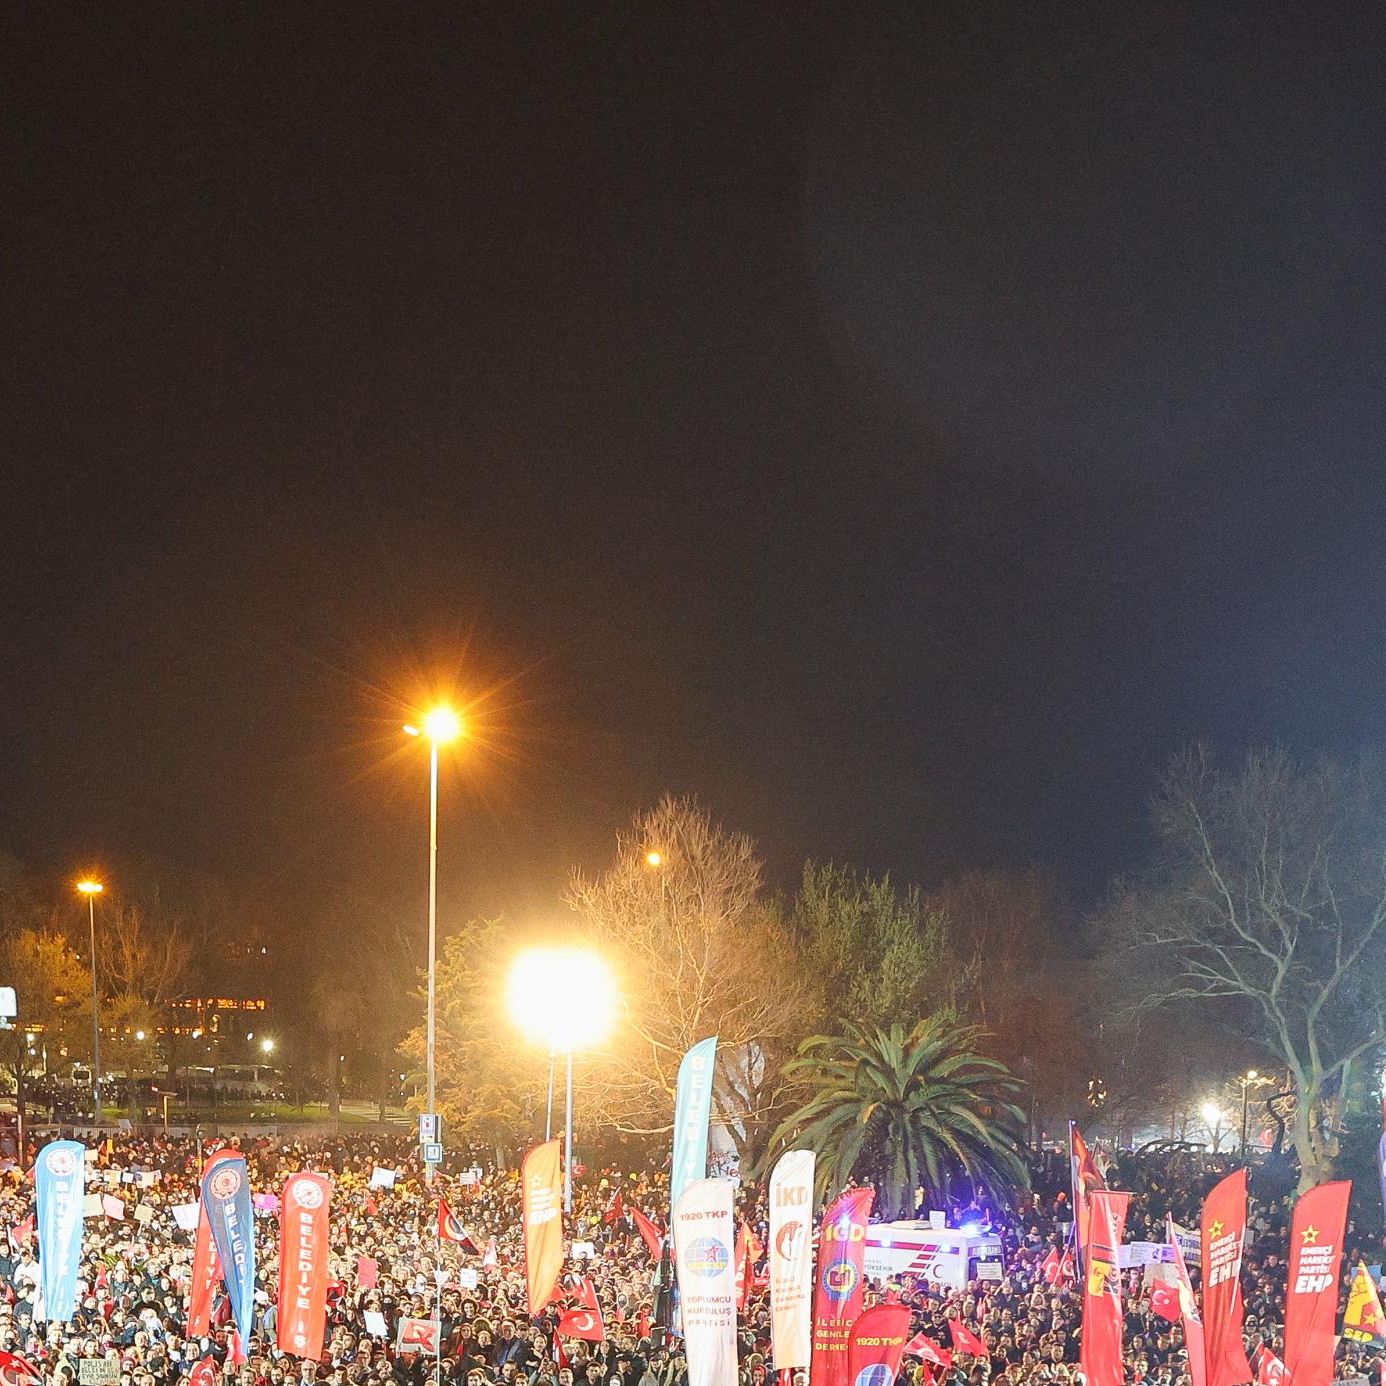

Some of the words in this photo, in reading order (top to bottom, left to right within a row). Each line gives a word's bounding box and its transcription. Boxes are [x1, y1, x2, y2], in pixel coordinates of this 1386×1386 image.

[680, 1212, 703, 1221] 1920
[705, 1210, 729, 1219] TKP
[298, 1213, 313, 1309] BELEDİYE
[1294, 1274, 1334, 1294] EHP
[856, 1337, 880, 1347] 1920
[1343, 1327, 1374, 1343] SEP
